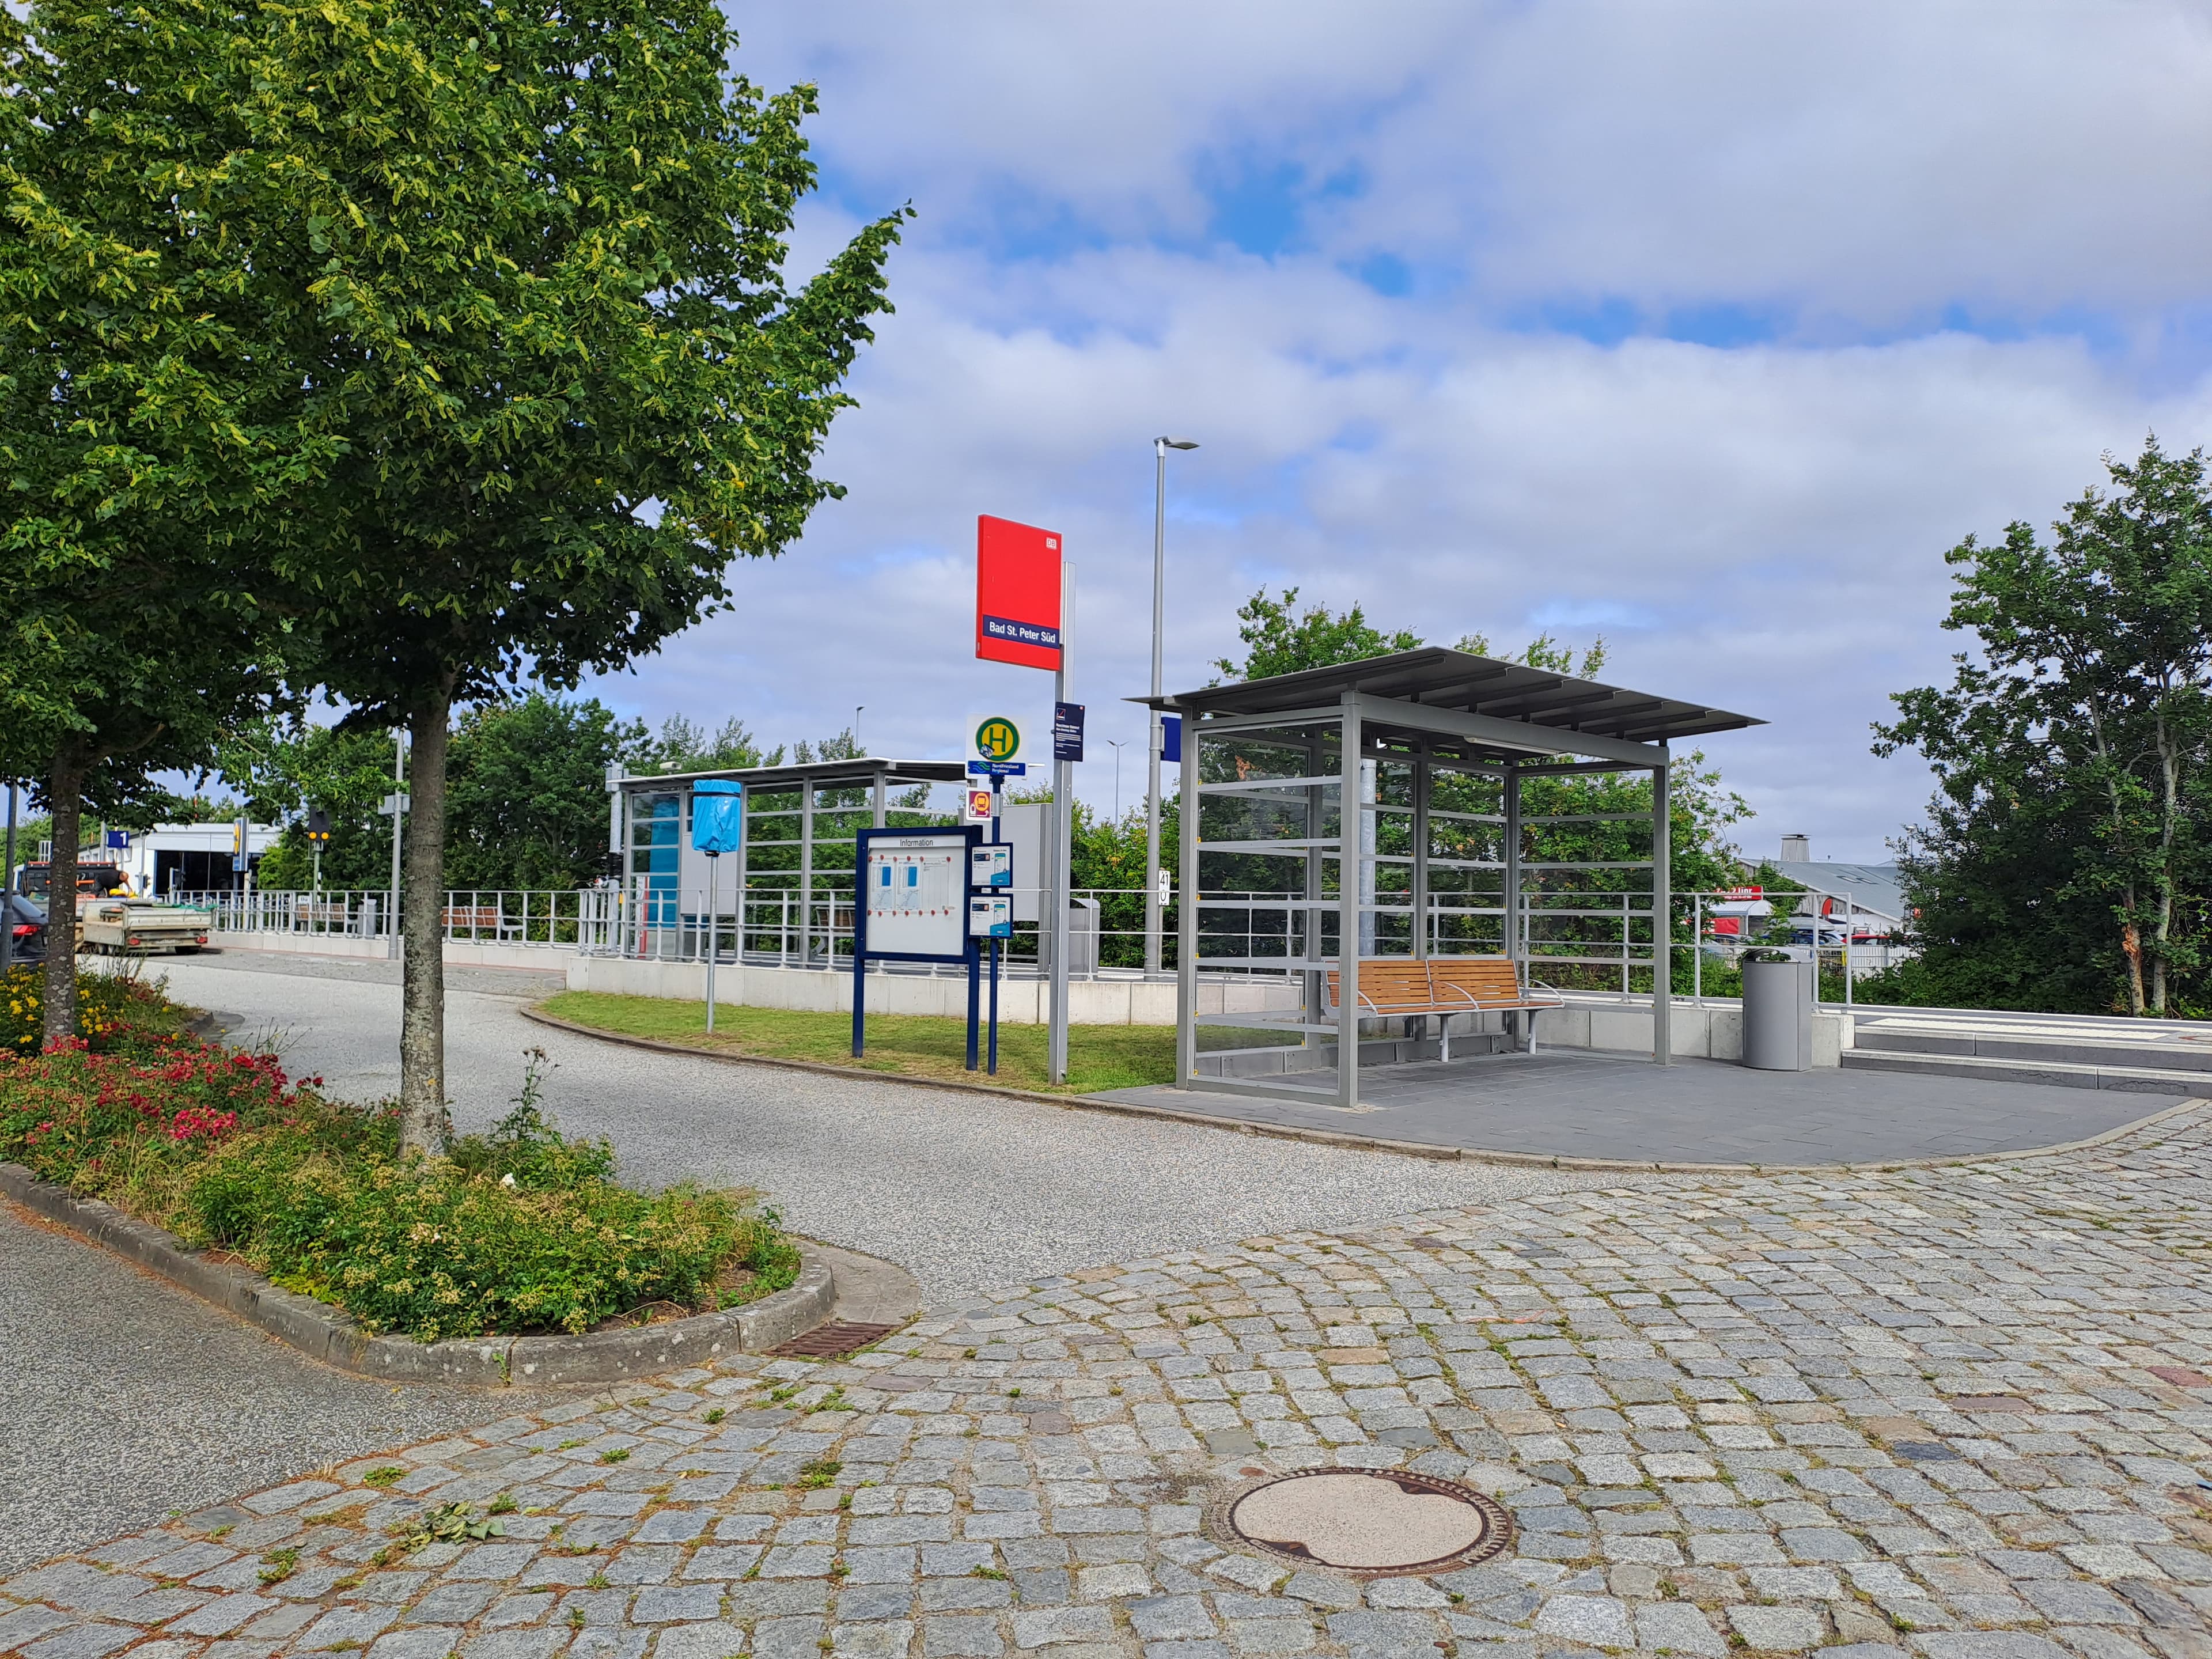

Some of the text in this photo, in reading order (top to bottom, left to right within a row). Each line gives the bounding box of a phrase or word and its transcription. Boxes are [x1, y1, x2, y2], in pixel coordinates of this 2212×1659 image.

[989, 621, 1056, 643] Bad St. Peter Süd
[989, 727, 1007, 752] H
[120, 831, 127, 846] 1
[900, 838, 934, 847] Information
[1160, 873, 1169, 885] 41
[1160, 890, 1166, 902] 0
